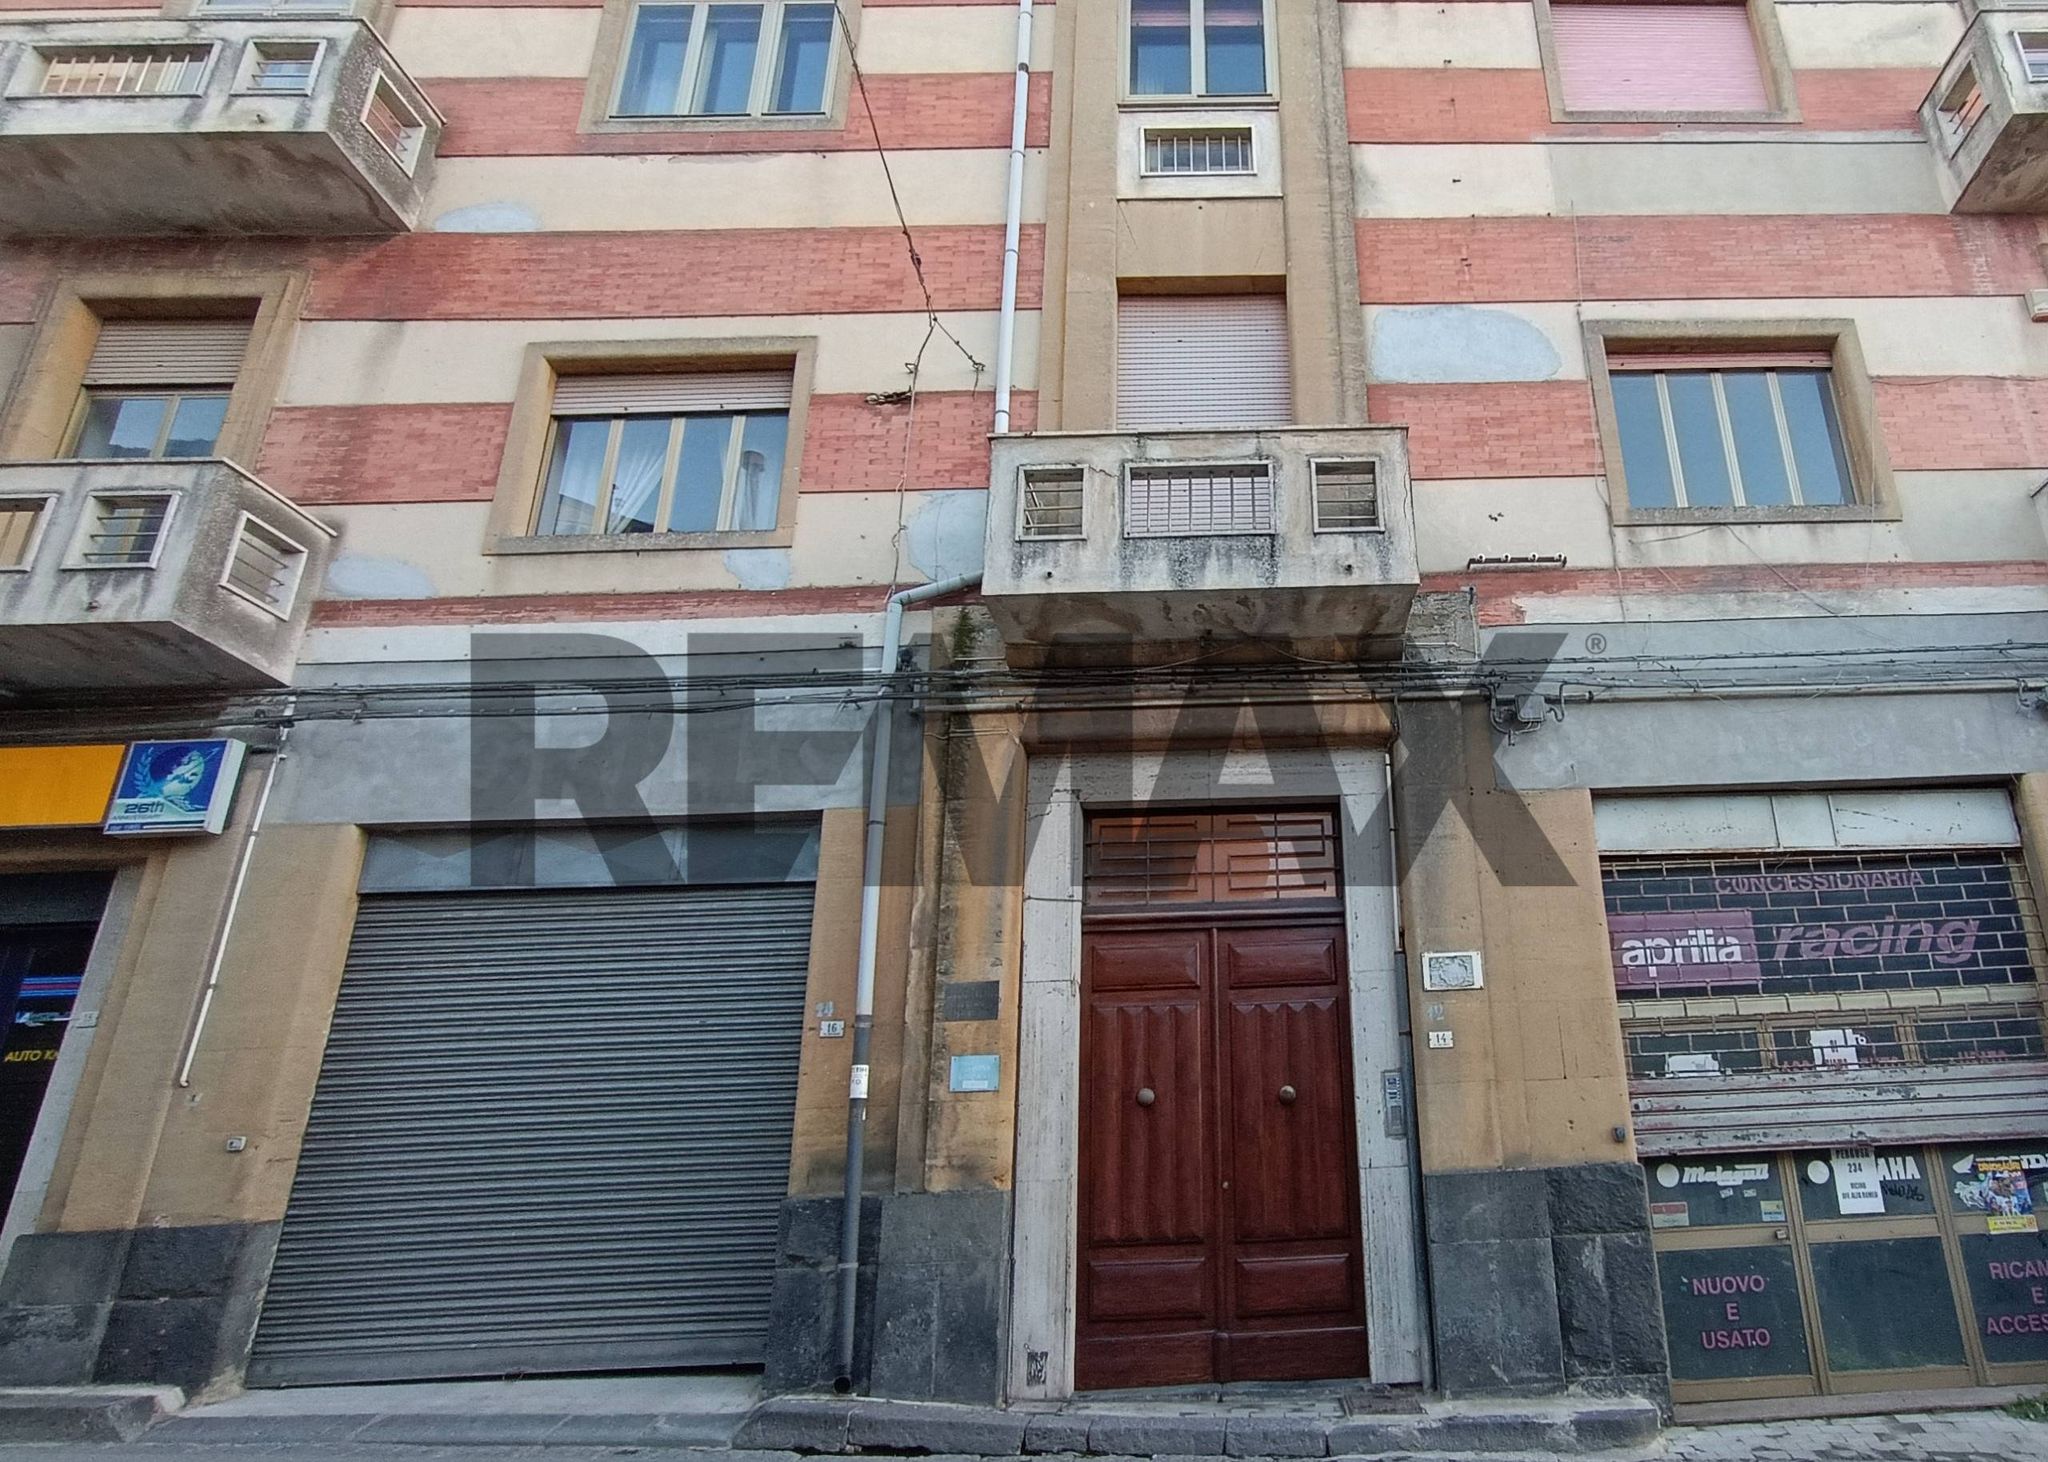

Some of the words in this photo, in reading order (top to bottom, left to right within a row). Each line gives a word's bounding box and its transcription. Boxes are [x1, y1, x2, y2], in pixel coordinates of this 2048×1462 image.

[124, 801, 165, 814] 26th
[1621, 929, 1742, 977] aprilia
[1773, 914, 1980, 965] racing
[4, 1050, 42, 1062] AUTO
[1847, 1163, 1863, 1173] 234
[1692, 1275, 1765, 1295] NUOVO
[2032, 1287, 2046, 1304] E
[1726, 1303, 1740, 1320] E
[1702, 1328, 1770, 1349] USATO
